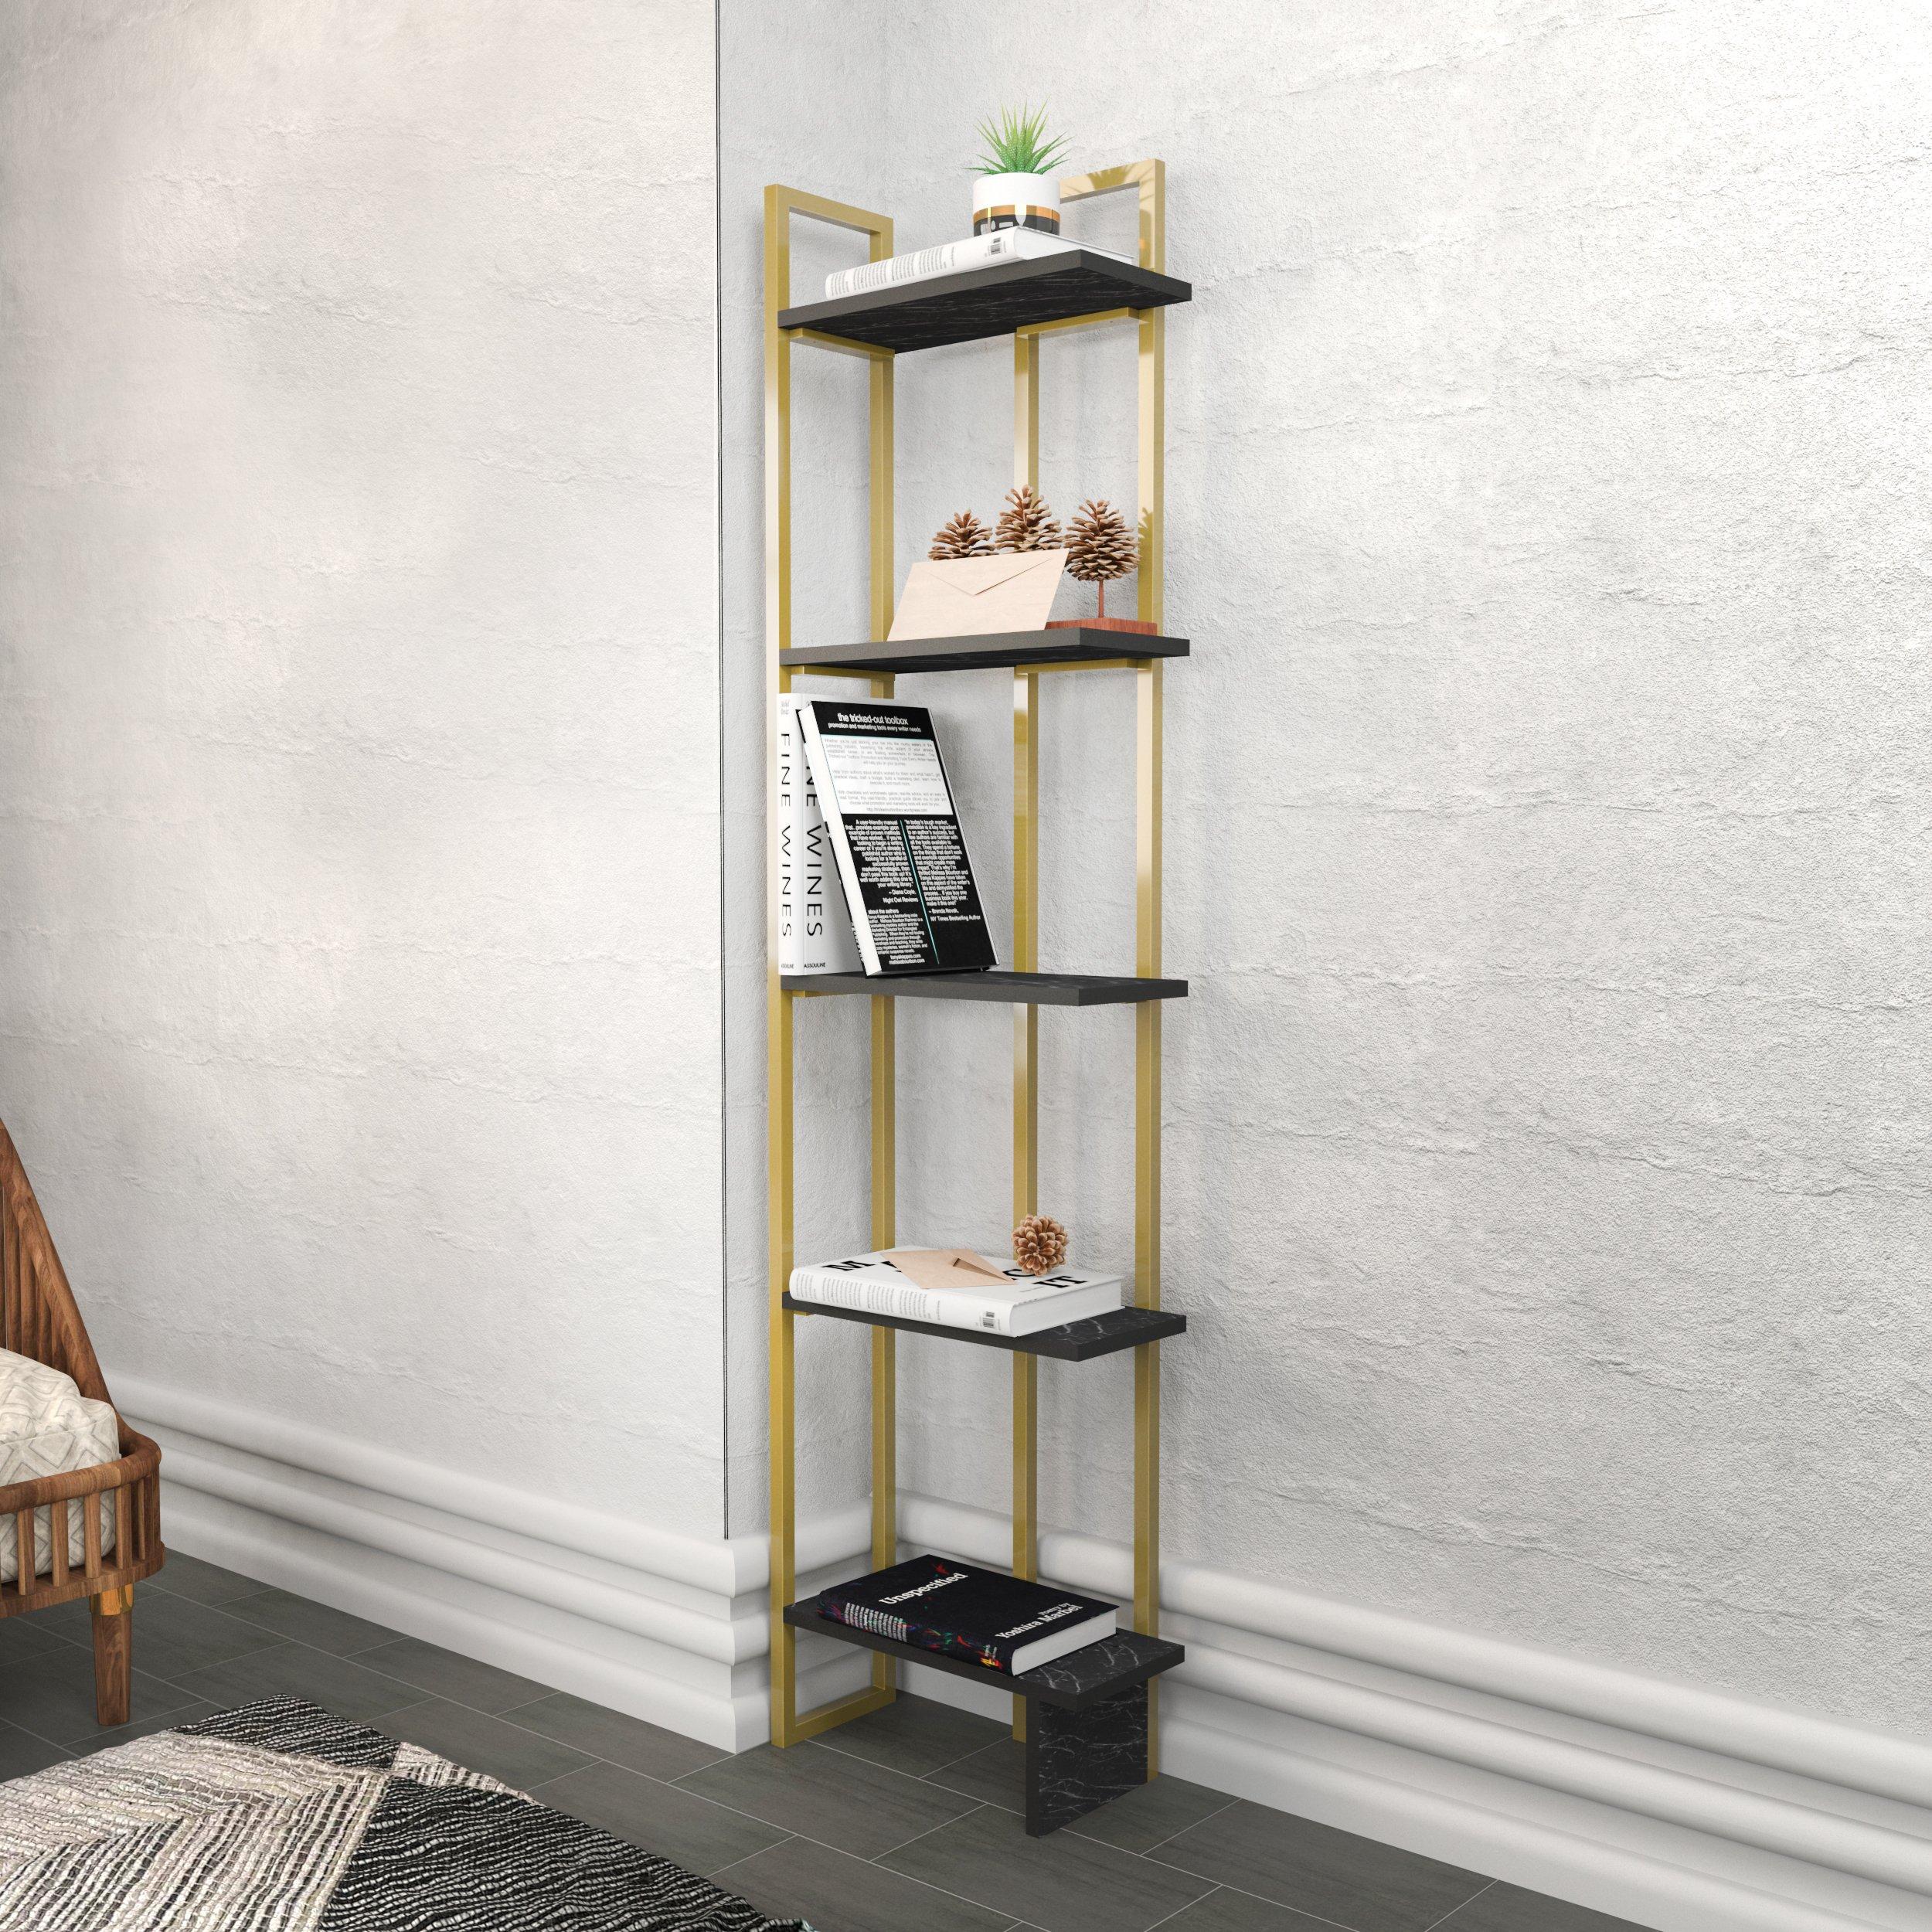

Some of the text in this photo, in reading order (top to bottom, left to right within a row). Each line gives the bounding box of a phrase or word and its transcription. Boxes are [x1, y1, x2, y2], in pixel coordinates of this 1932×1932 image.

[837, 713, 909, 726] the tricked-out toolbox
[781, 733, 791, 936] FINE WINES
[807, 825, 822, 936] WINES
[879, 1573, 969, 1604] Unspecified
[995, 1604, 1083, 1638] Yoshira Marbel
